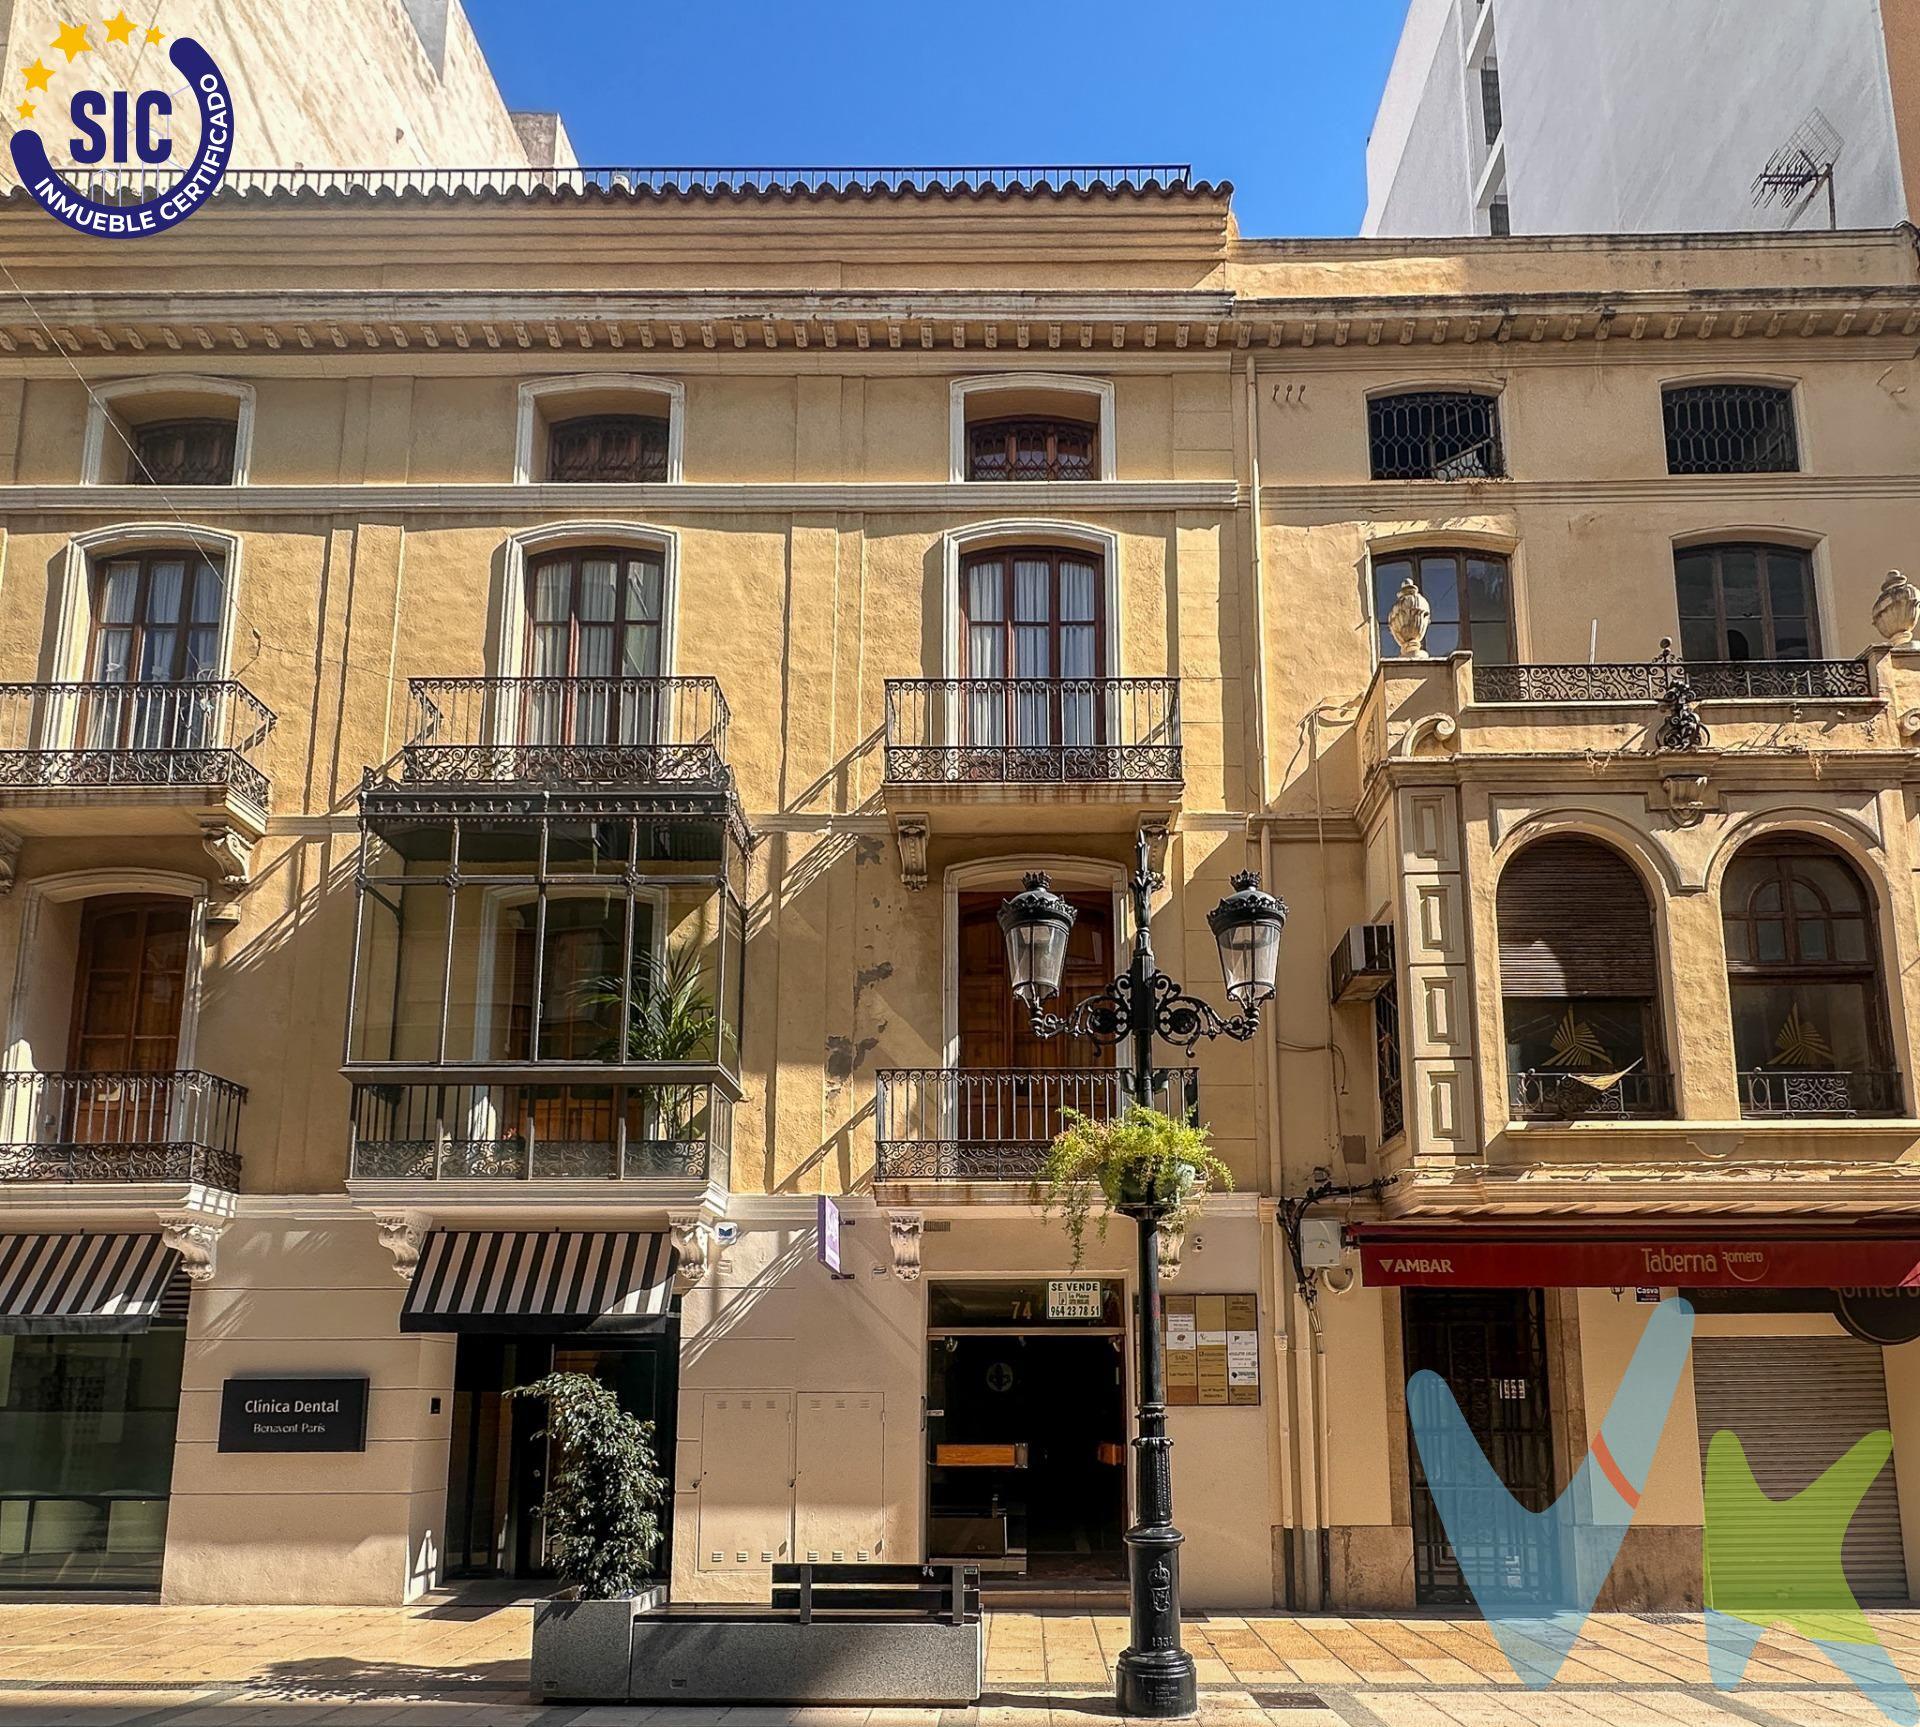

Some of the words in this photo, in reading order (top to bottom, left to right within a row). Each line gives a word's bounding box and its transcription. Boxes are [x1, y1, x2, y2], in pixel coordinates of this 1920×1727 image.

[1394, 1259, 1455, 1273] AMBAR
[1641, 1248, 1718, 1273] Taberna
[1051, 1282, 1063, 1291] SE
[1066, 1282, 1098, 1291] VENDE
[1011, 1301, 1032, 1319] 74
[1050, 1305, 1065, 1316] 964
[1067, 1305, 1077, 1316] 23
[1079, 1305, 1089, 1316] 78
[1090, 1305, 1100, 1316] 51
[244, 1399, 290, 1413] Clínica
[294, 1399, 340, 1413] Dental
[253, 1423, 298, 1433] Benavent
